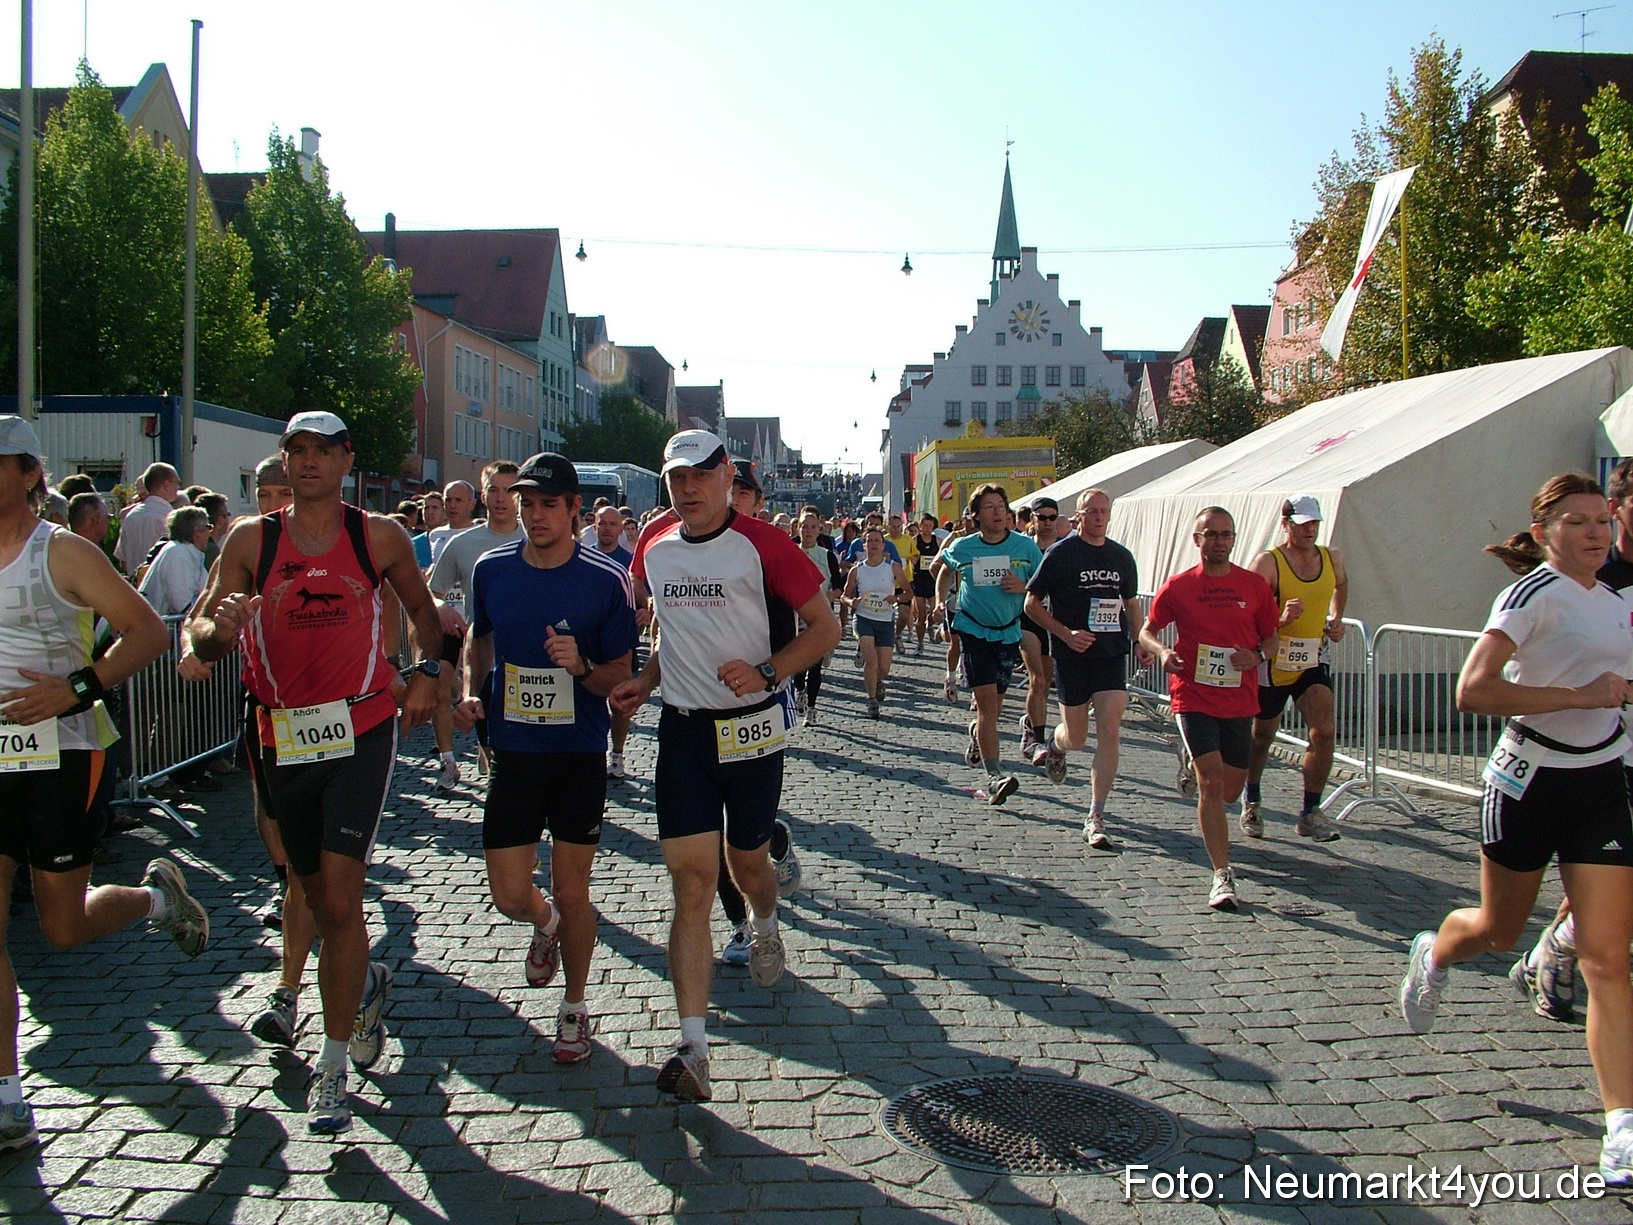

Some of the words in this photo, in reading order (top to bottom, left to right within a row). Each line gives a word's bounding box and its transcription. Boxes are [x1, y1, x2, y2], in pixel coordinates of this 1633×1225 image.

[983, 569, 1007, 577] 3583
[1080, 570, 1121, 582] SYSCAD
[663, 583, 726, 598] ERDINGER
[664, 600, 727, 608] ALKOHOLFREI
[870, 600, 883, 608] 770
[1096, 612, 1118, 623] 3392
[1210, 650, 1225, 660] Karl
[1288, 651, 1309, 662] 696
[1209, 663, 1226, 676] 76
[508, 685, 516, 696] C
[521, 691, 557, 709] 987
[296, 722, 347, 746] 1040
[721, 726, 730, 737] C
[737, 719, 773, 745] 985
